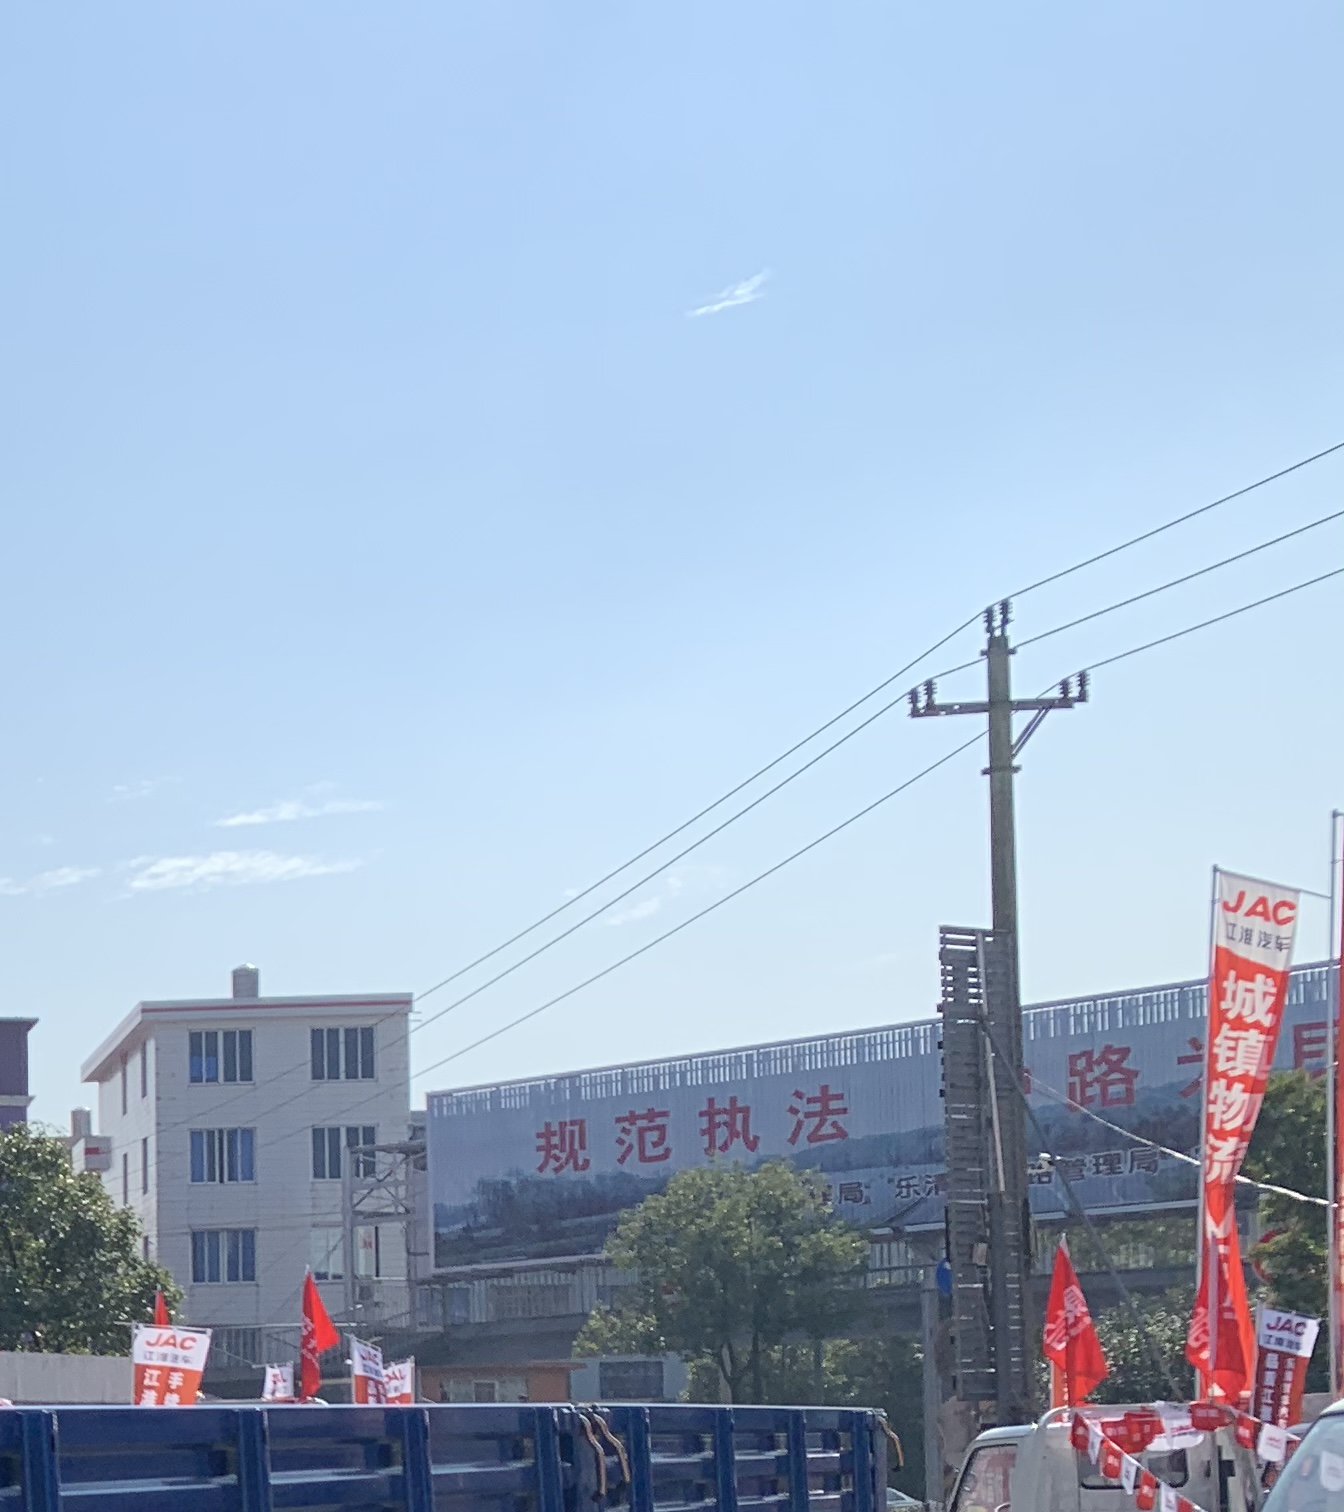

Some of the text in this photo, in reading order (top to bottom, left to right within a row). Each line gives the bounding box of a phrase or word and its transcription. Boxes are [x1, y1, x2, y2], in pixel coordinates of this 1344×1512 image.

[1222, 890, 1297, 926] JAC
[534, 1084, 850, 1176] 规范执法
[145, 1333, 197, 1350] JAC
